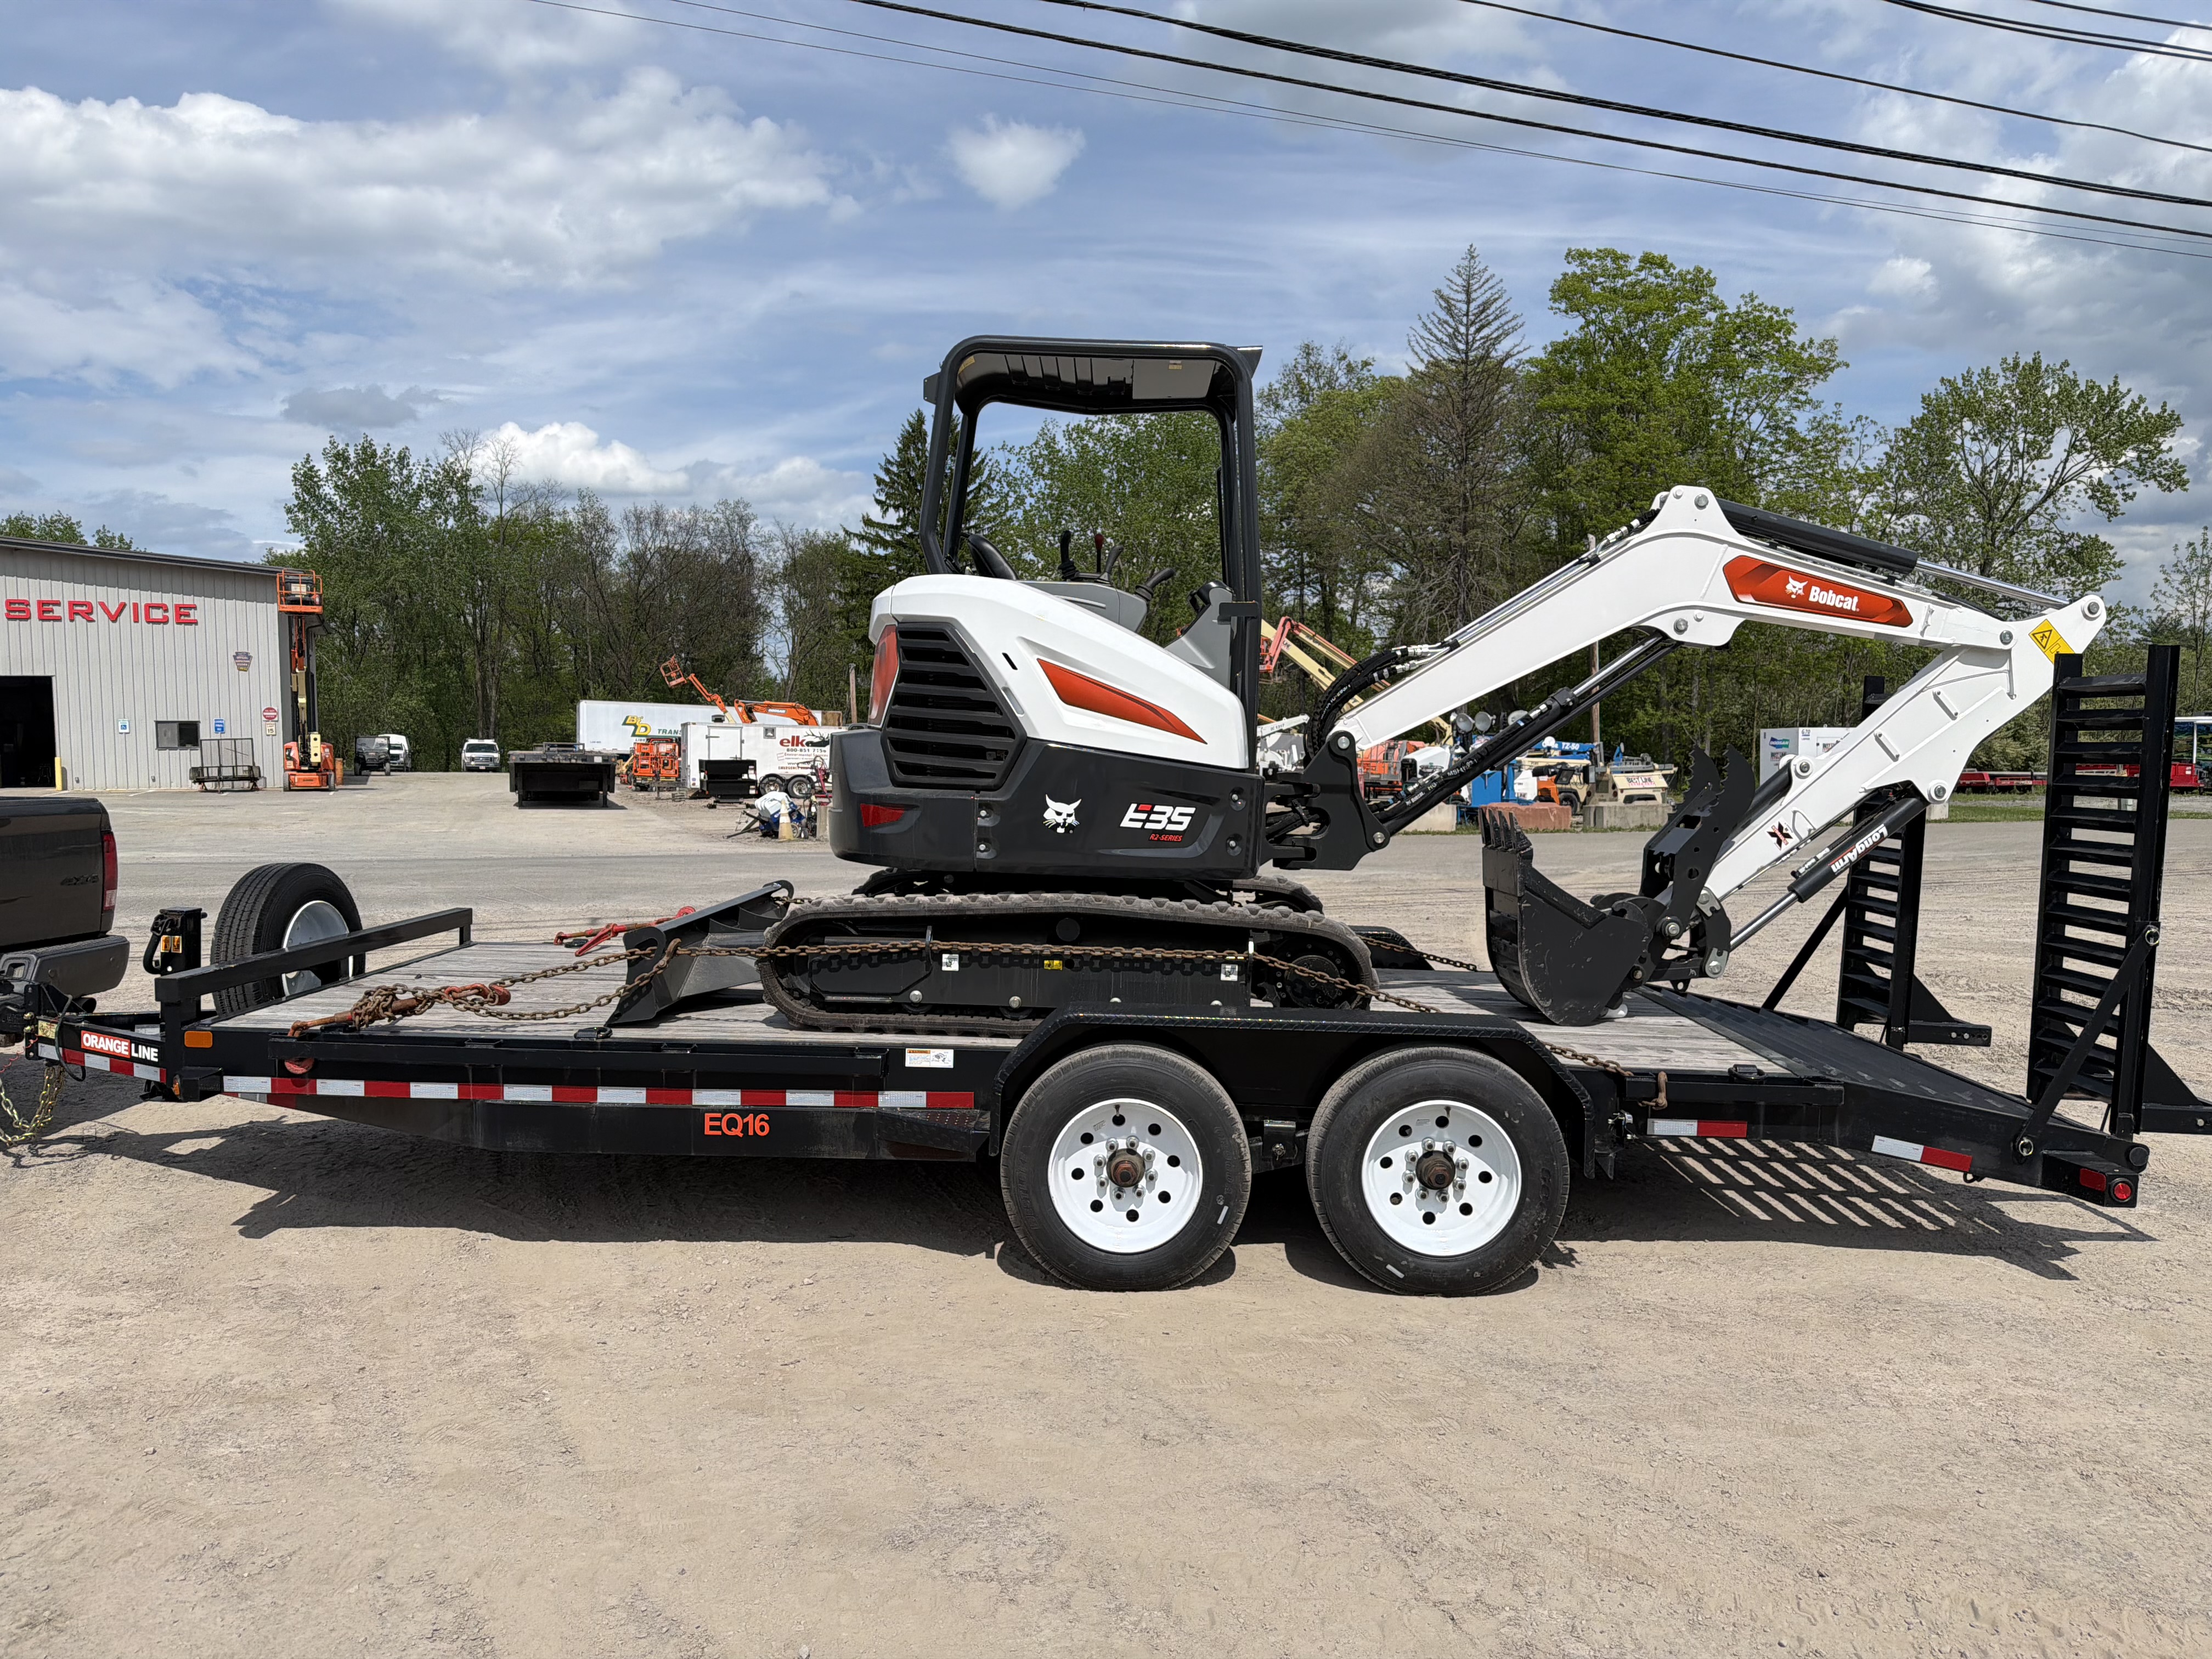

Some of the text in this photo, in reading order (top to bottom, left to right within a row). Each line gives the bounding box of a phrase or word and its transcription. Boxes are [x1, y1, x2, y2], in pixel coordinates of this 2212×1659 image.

[5, 599, 198, 624] SERVICE
[1809, 585, 1859, 612] Bobcat
[779, 735, 806, 747] elk
[1120, 803, 1196, 831] E35
[1149, 833, 1183, 842] R2-SERIES
[1831, 825, 1888, 874] LongArm
[83, 1033, 159, 1062] ORANGE LINE
[704, 1113, 770, 1137] EQ16
